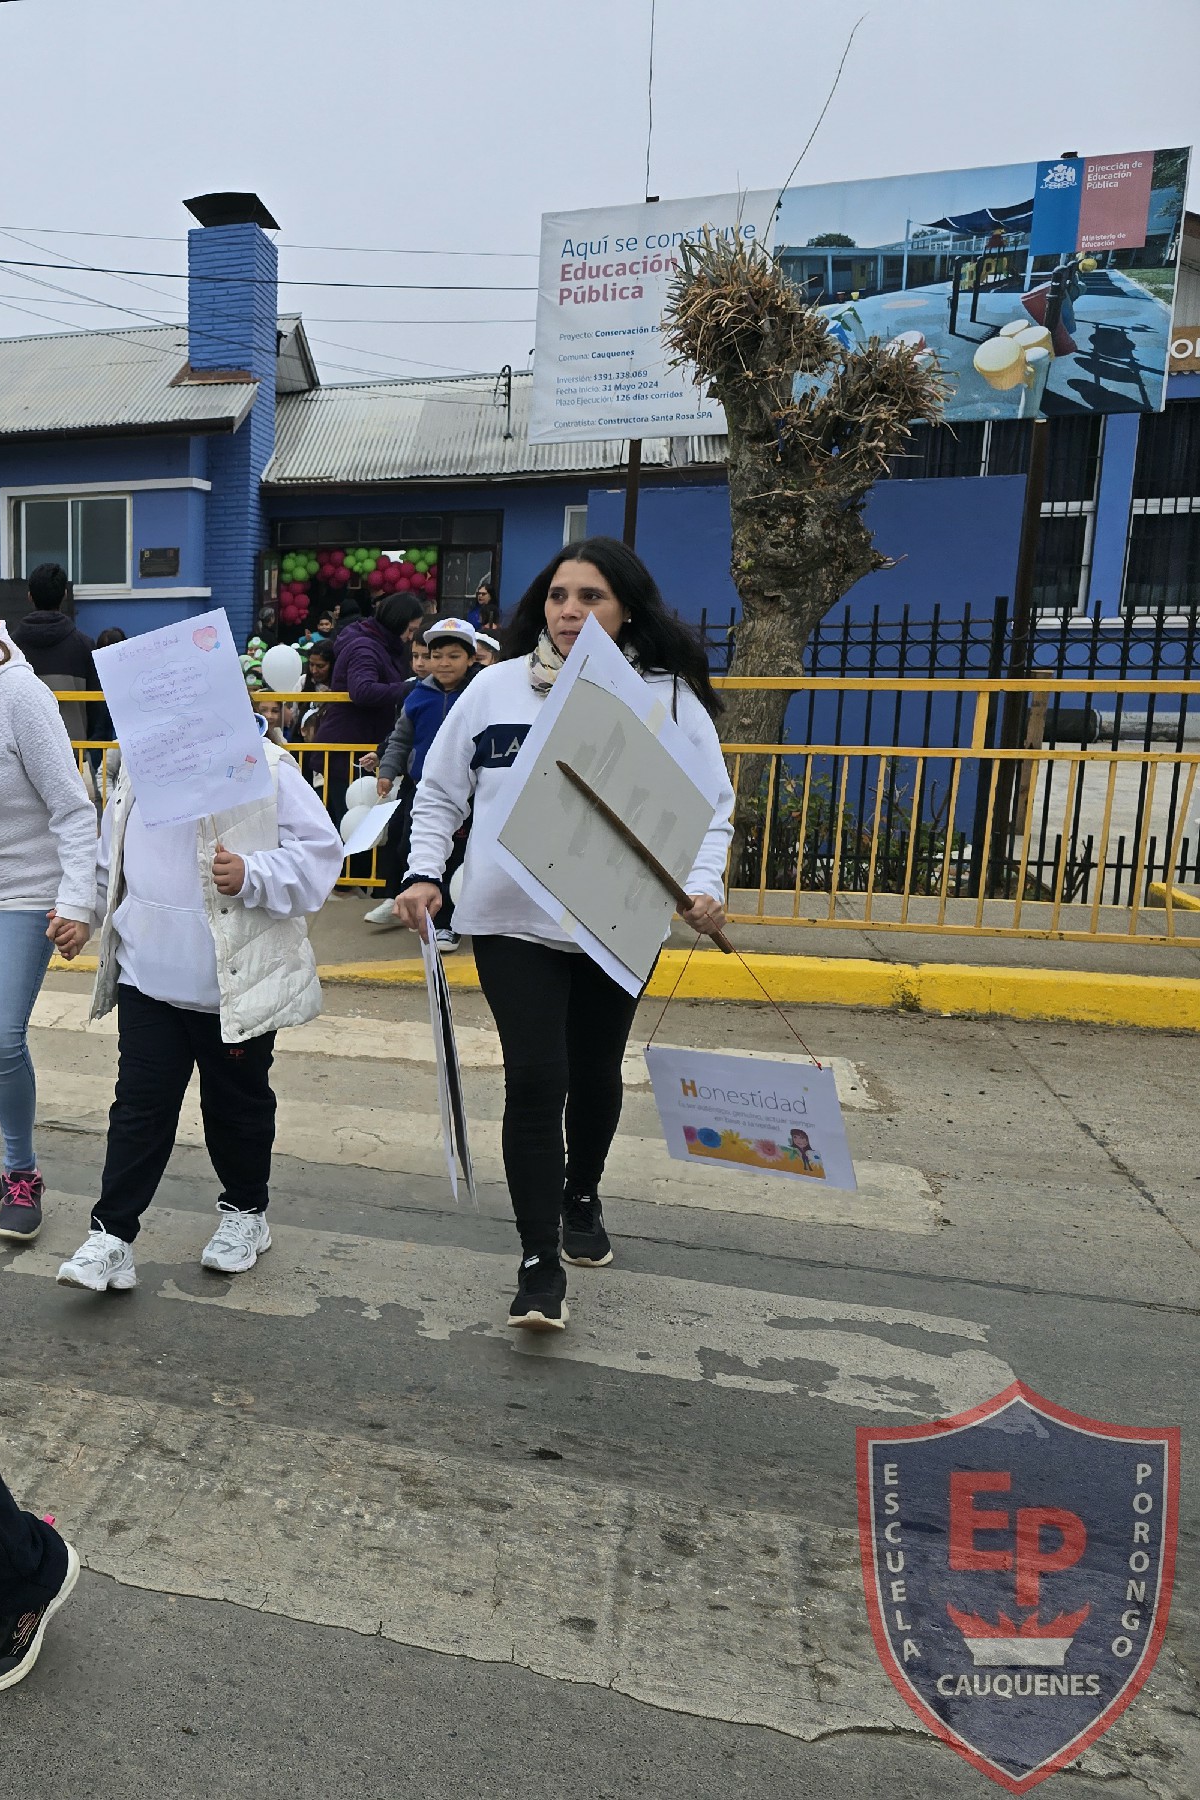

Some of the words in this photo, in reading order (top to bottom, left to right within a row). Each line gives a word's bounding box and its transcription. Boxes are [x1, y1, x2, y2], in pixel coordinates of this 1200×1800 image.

[1088, 161, 1130, 172] Dirección
[1131, 160, 1143, 168] de
[1087, 170, 1132, 182] Educación
[1086, 181, 1119, 190] Pública
[1082, 232, 1116, 242] Ministerio
[561, 235, 609, 260] Aquí
[615, 237, 638, 252] se
[1081, 239, 1115, 248] Educación
[560, 254, 678, 282] Educación
[559, 282, 644, 306] Pública
[559, 332, 594, 341] Proyecto:
[595, 326, 649, 338] Conservación
[558, 354, 589, 362] Comuna:
[591, 349, 635, 359] Cauquenes
[556, 374, 592, 384] Inversión:
[614, 382, 635, 391] Mayo
[638, 381, 659, 389] 2024
[632, 392, 649, 401] días
[650, 390, 683, 399] corridos
[598, 416, 649, 426] Constructora
[650, 414, 674, 422] Santa
[696, 411, 713, 419] SPA
[680, 1078, 808, 1115] Honestidad
